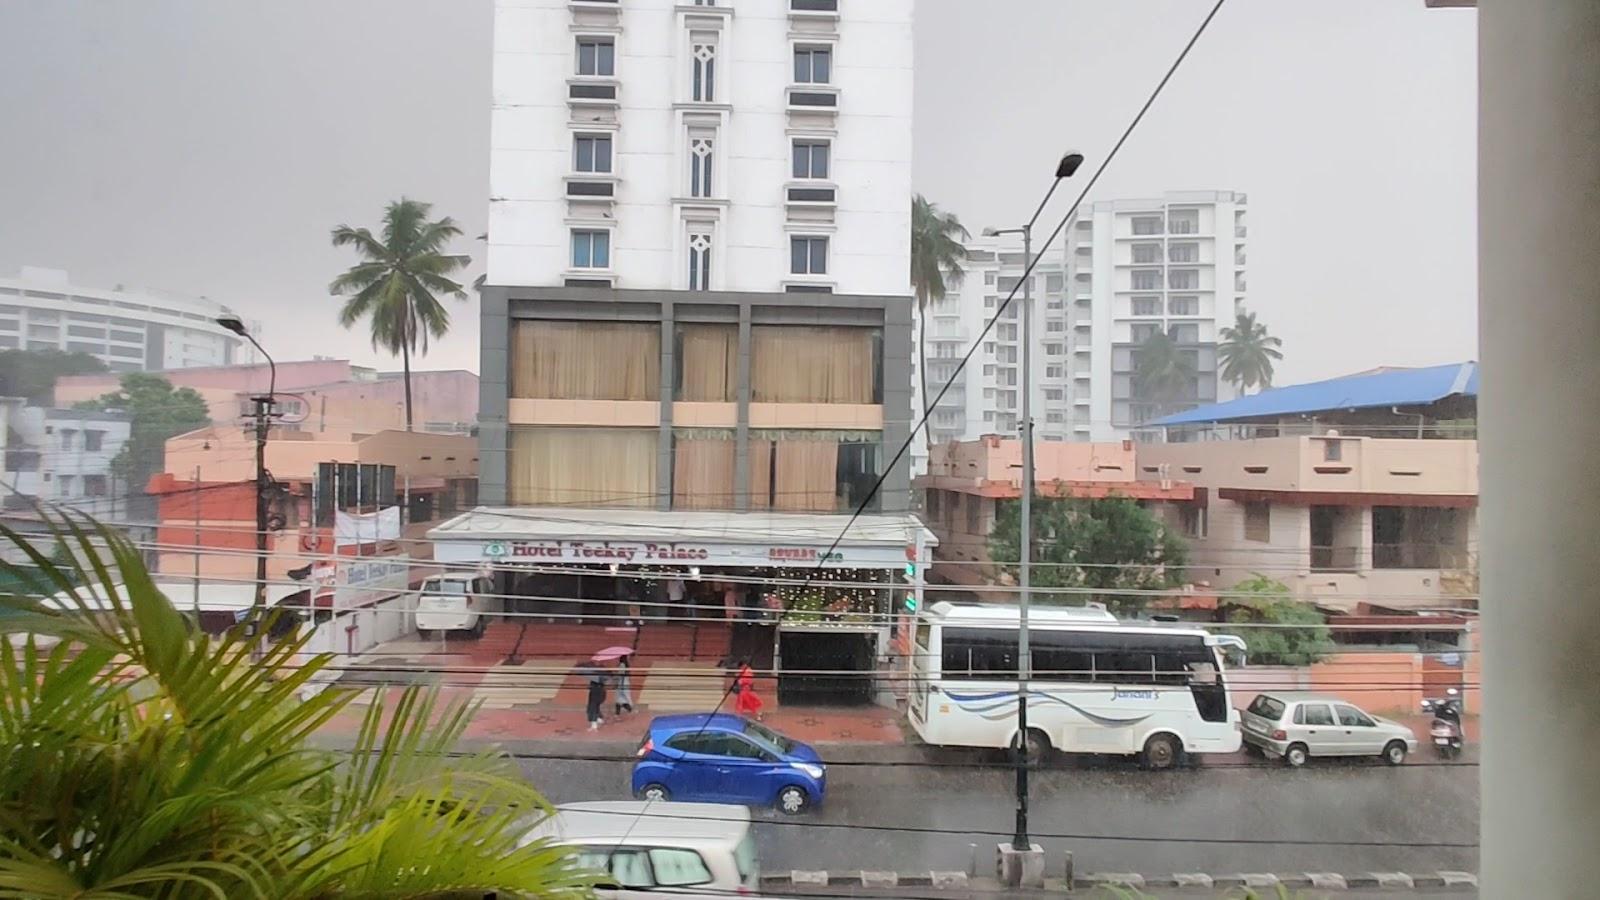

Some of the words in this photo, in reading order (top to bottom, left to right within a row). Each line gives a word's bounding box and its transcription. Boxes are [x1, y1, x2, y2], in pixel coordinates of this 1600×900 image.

[512, 540, 563, 557] Hotel
[570, 541, 638, 560] Teekay
[644, 543, 709, 560] Palace
